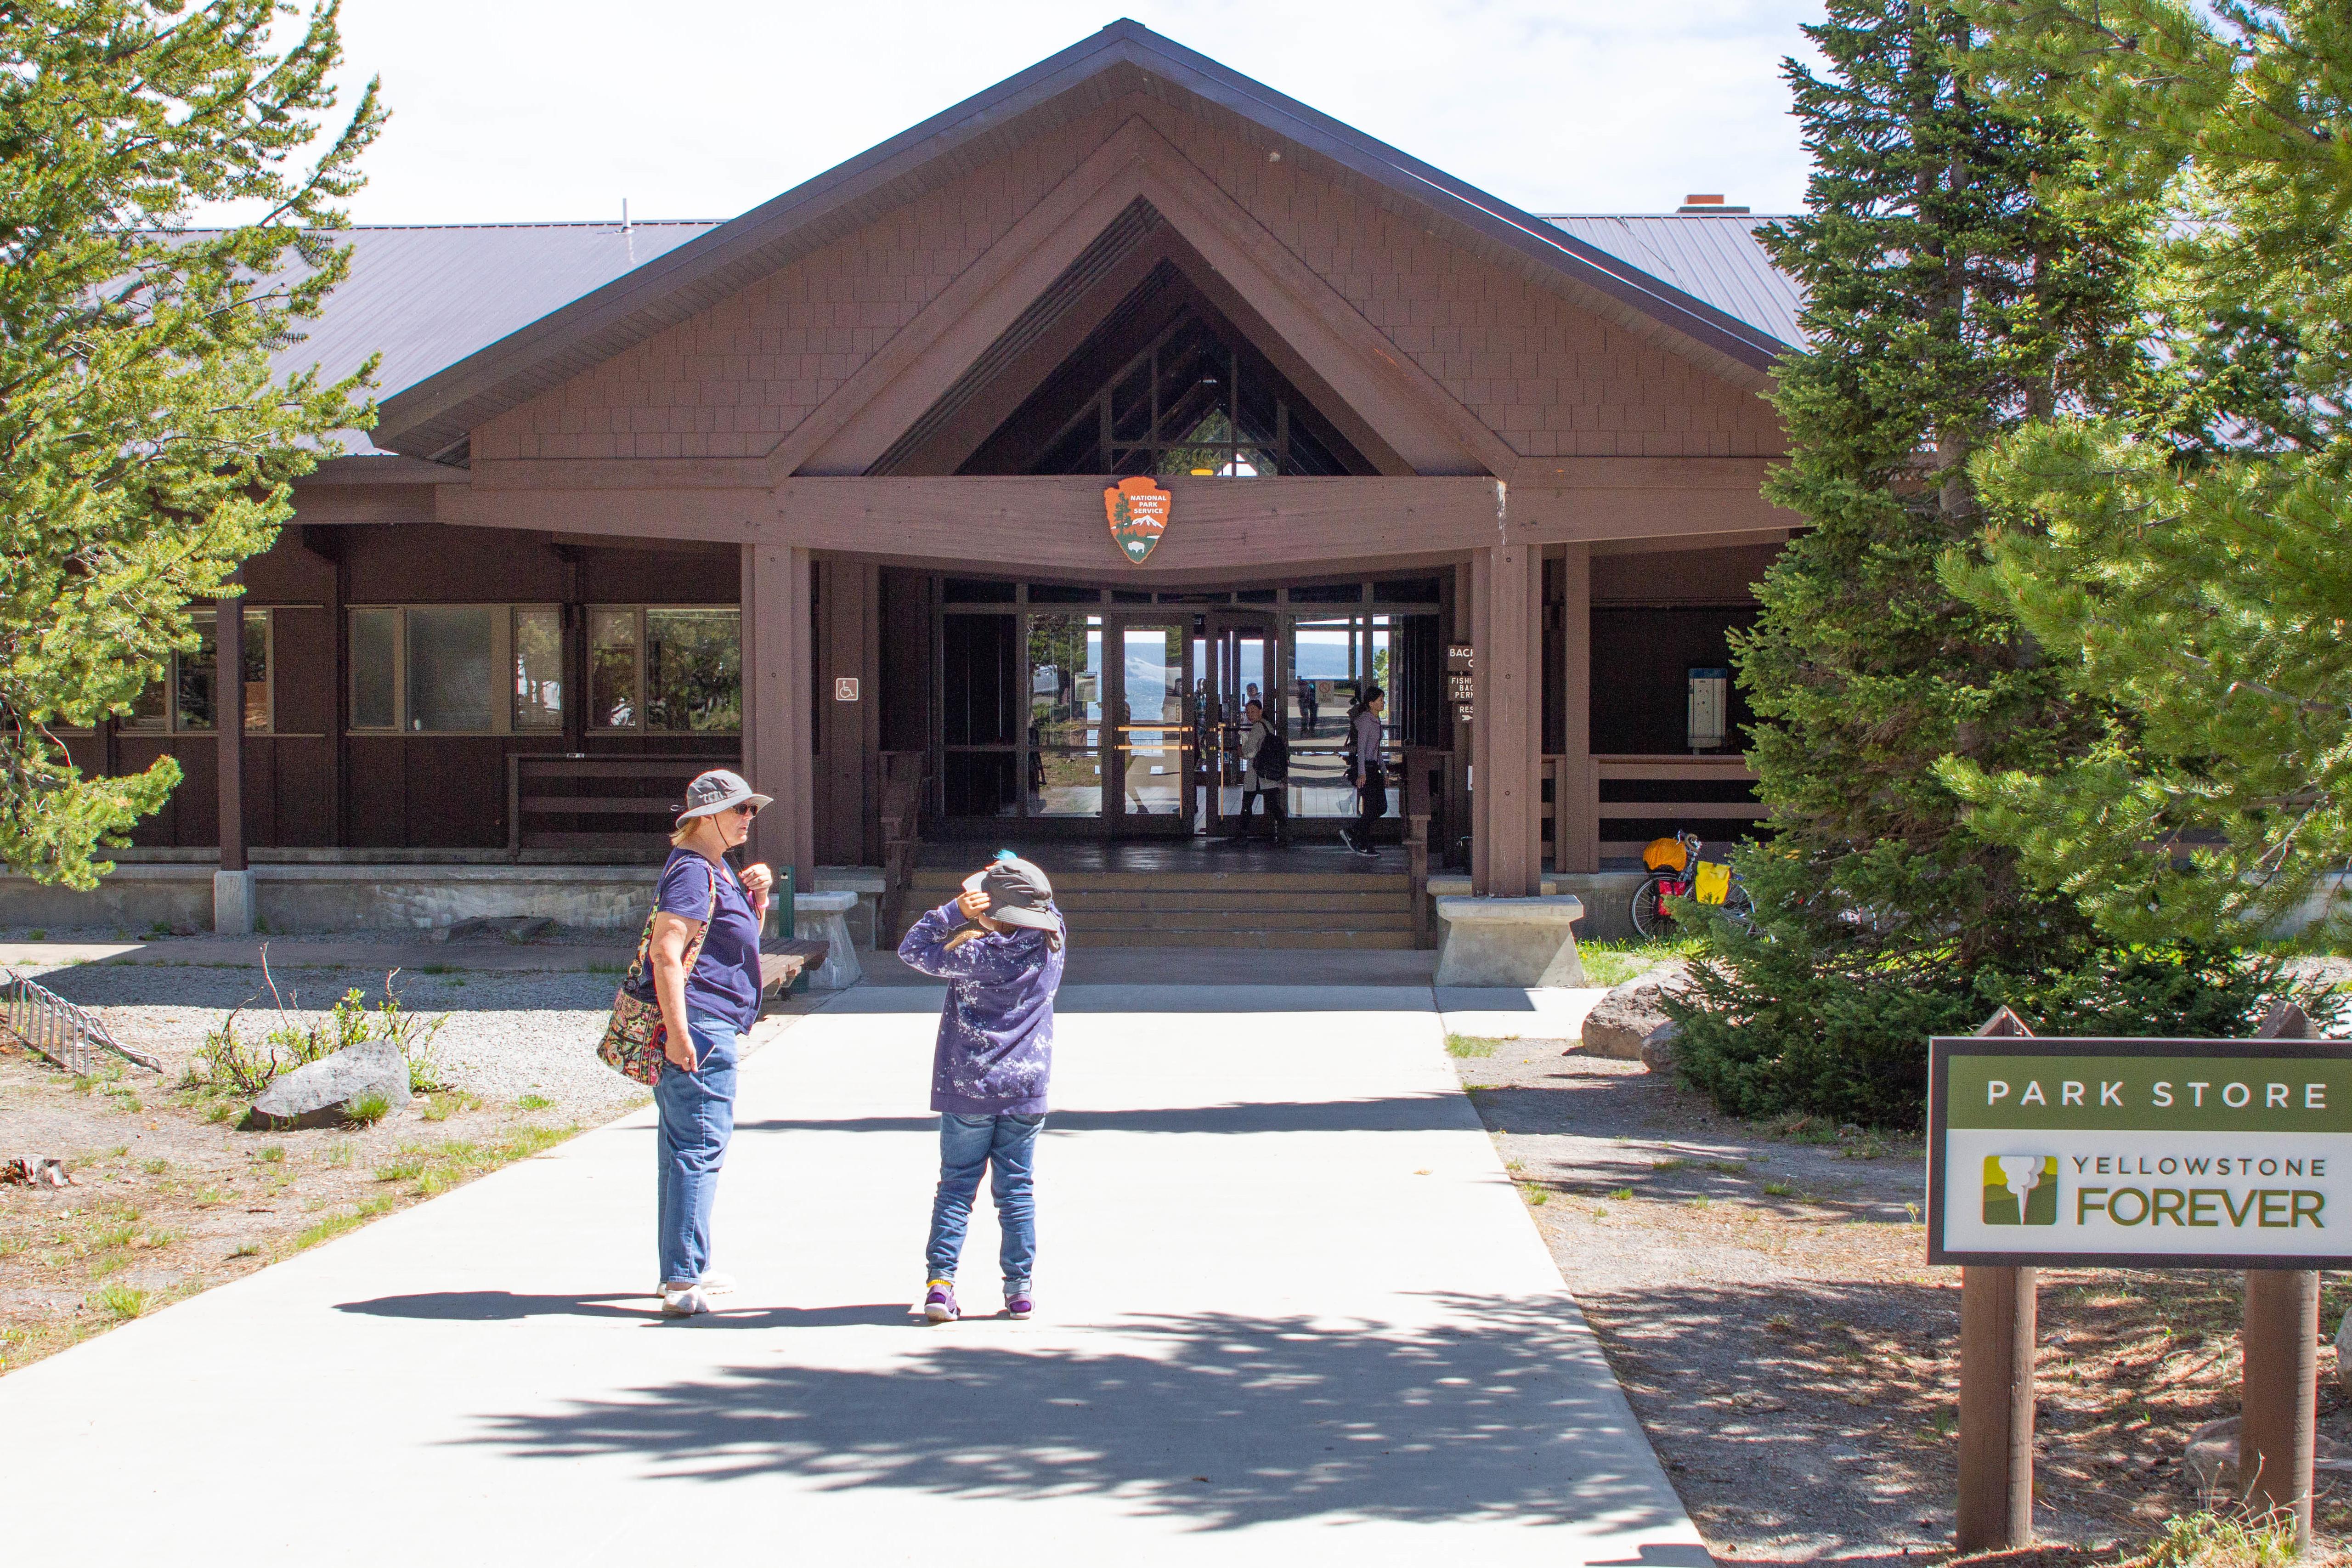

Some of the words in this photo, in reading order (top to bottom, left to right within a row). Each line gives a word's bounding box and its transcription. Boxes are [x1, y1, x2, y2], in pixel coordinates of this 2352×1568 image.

[1987, 1080, 2124, 1106] PARK
[2151, 1081, 2327, 1109] STORE
[2072, 1156, 2326, 1177] YELLOWSTONE
[2076, 1187, 2325, 1228] FOREVER
